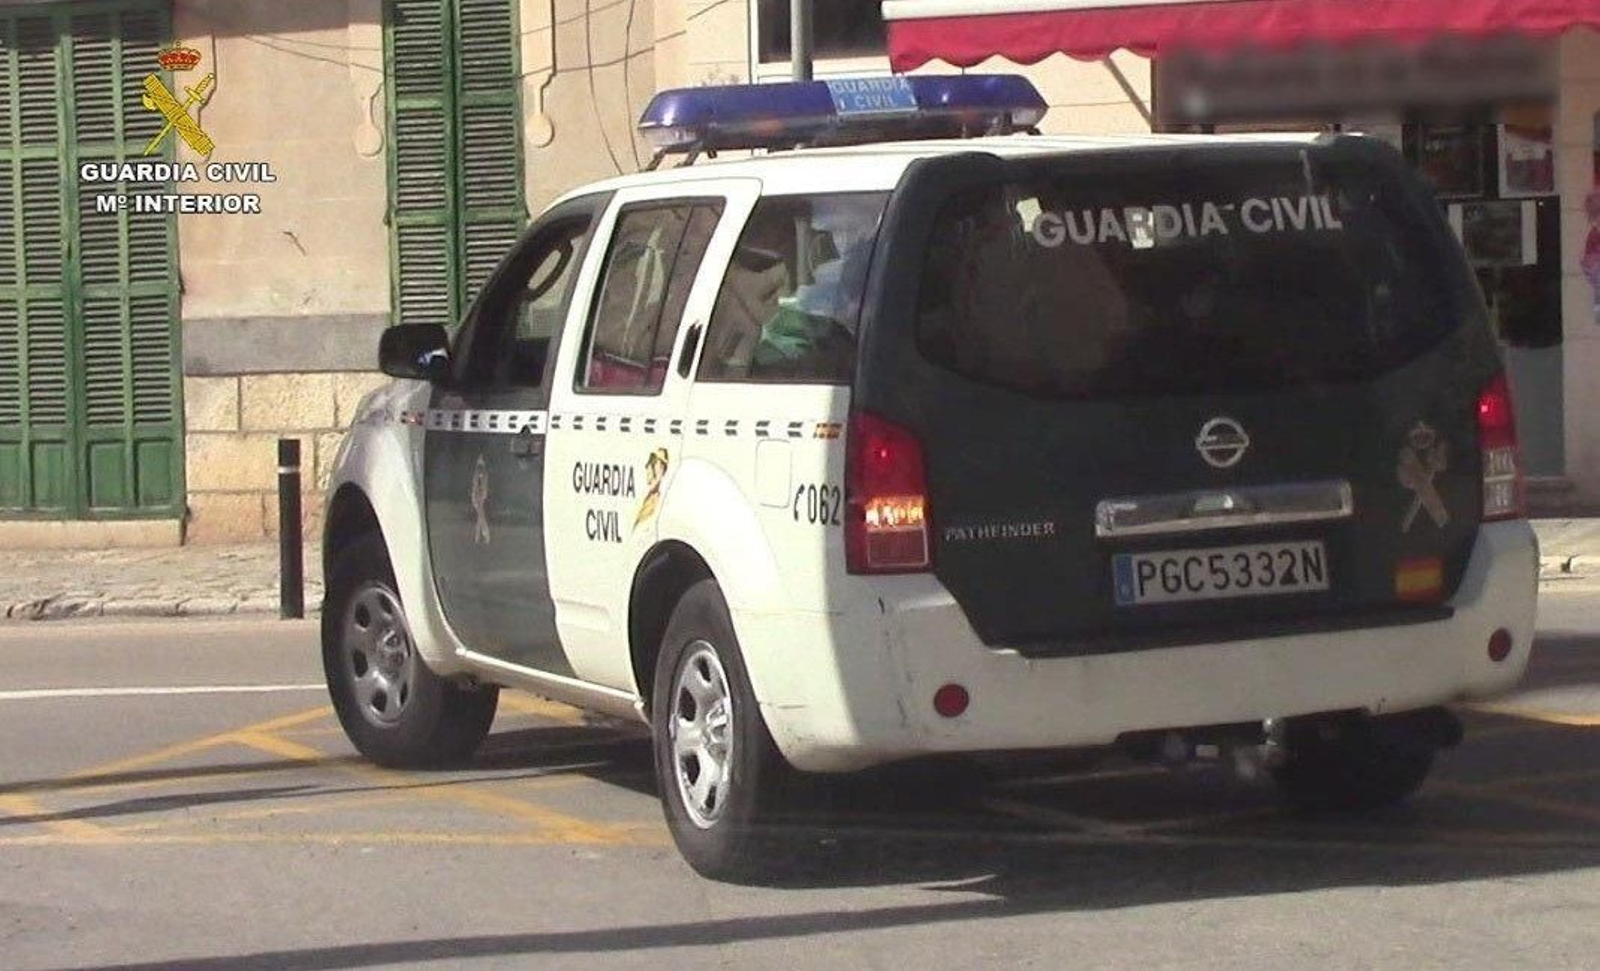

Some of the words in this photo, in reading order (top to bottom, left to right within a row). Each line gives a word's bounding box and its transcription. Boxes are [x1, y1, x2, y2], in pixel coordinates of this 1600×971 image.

[854, 93, 899, 109] CIVIL
[1033, 201, 1229, 248] GUARDIA
[1241, 194, 1344, 233] CIVIL
[572, 461, 636, 498] GUARDIA
[807, 483, 841, 526] 062
[585, 508, 622, 543] CIVIL
[944, 521, 1055, 542] PATHFINDER
[1136, 545, 1324, 598] PGC5332N
